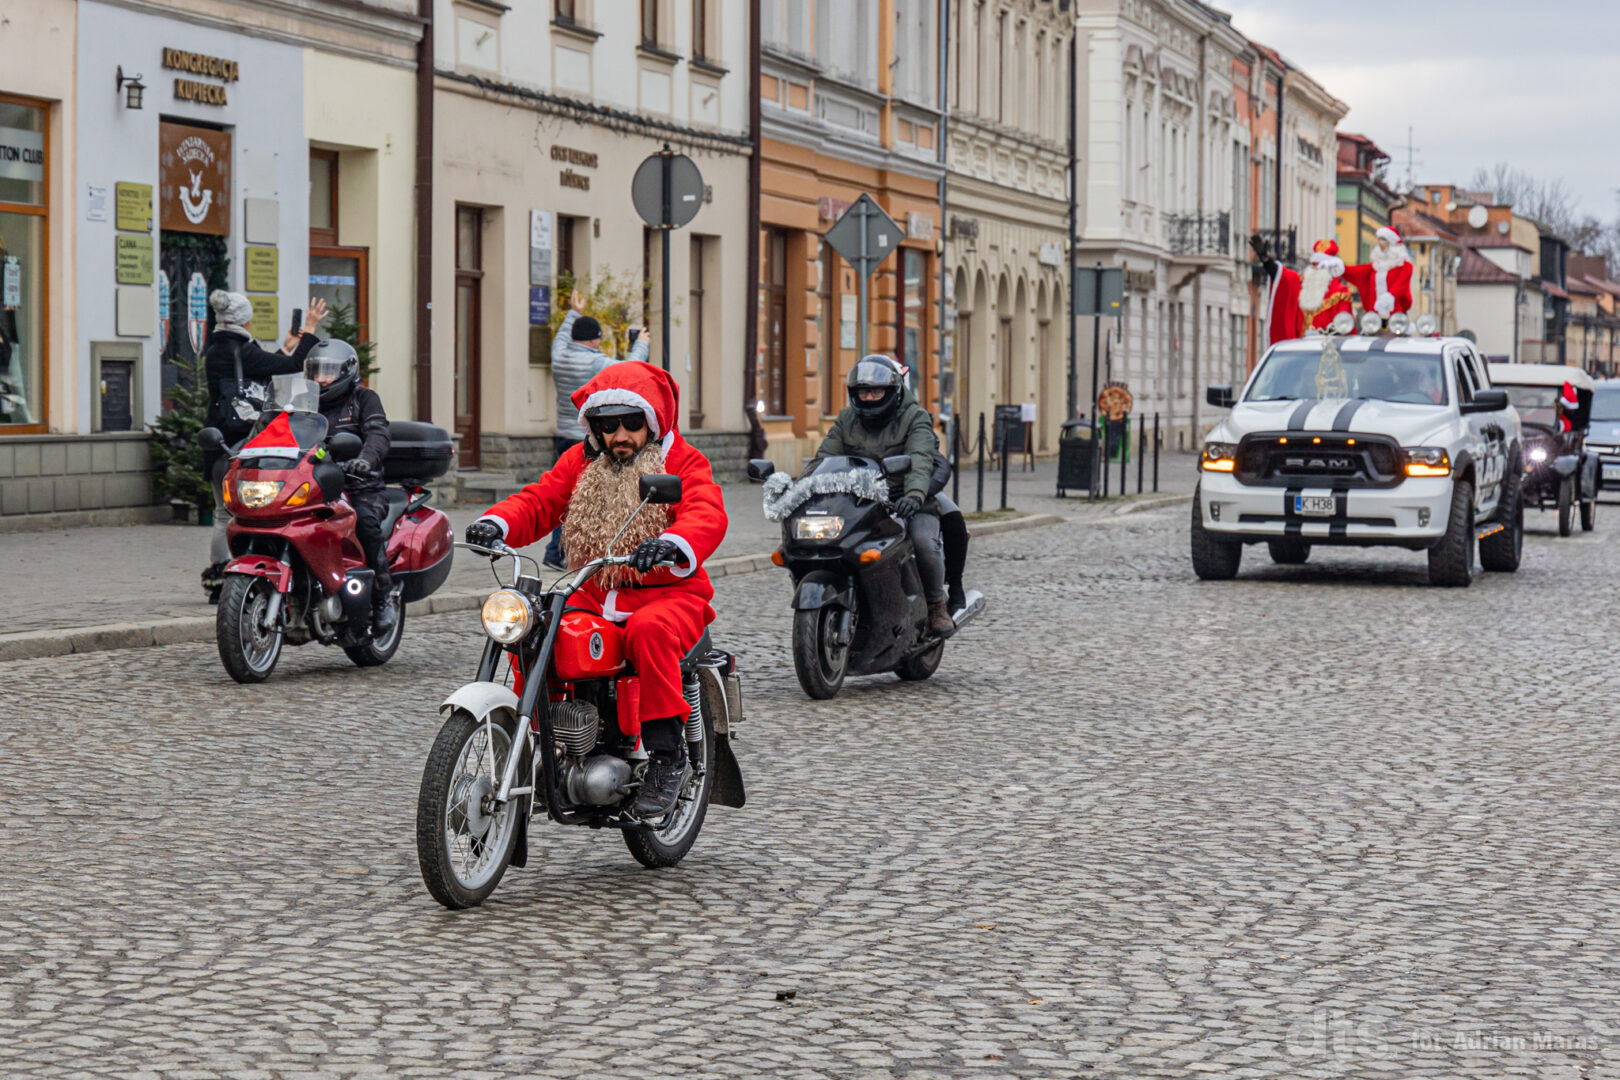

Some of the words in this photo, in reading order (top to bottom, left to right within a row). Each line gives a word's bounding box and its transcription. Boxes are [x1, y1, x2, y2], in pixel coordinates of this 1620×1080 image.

[162, 47, 239, 83] KONGREGACJA
[173, 78, 227, 106] KUPIECKA
[22, 147, 44, 165] CLUB
[1286, 458, 1349, 468] RAM
